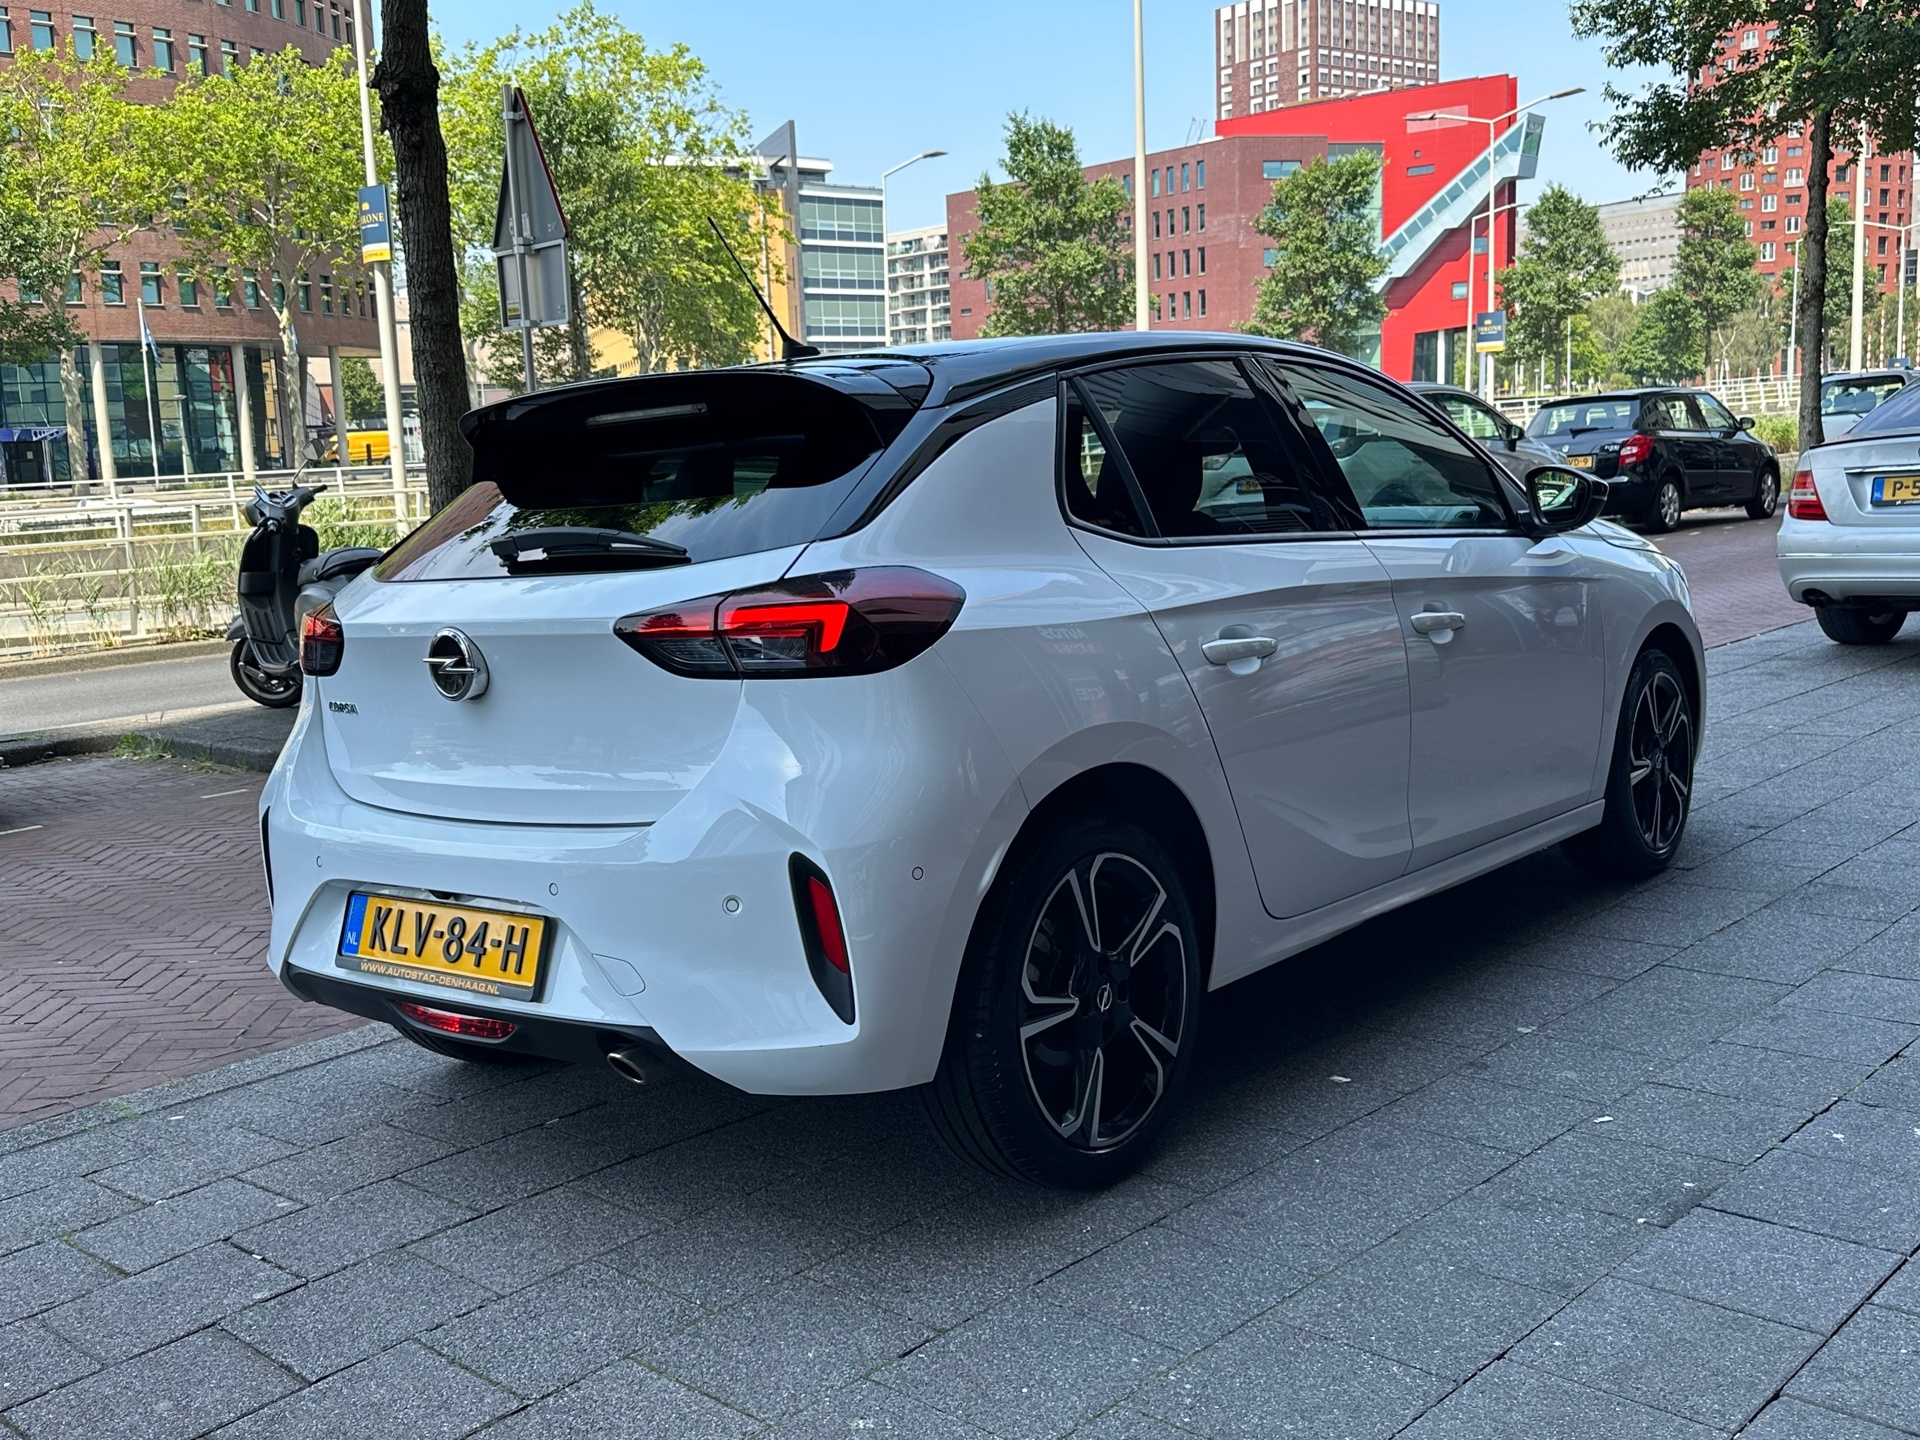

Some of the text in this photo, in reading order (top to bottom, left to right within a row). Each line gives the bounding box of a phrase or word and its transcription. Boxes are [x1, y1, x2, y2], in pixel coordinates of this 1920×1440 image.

[329, 701, 359, 715] CORSA
[346, 930, 358, 945] NL
[369, 906, 529, 975] KLV-84-H
[360, 961, 500, 995] WWW.AUTOSTAD-DENHAAG.NL
